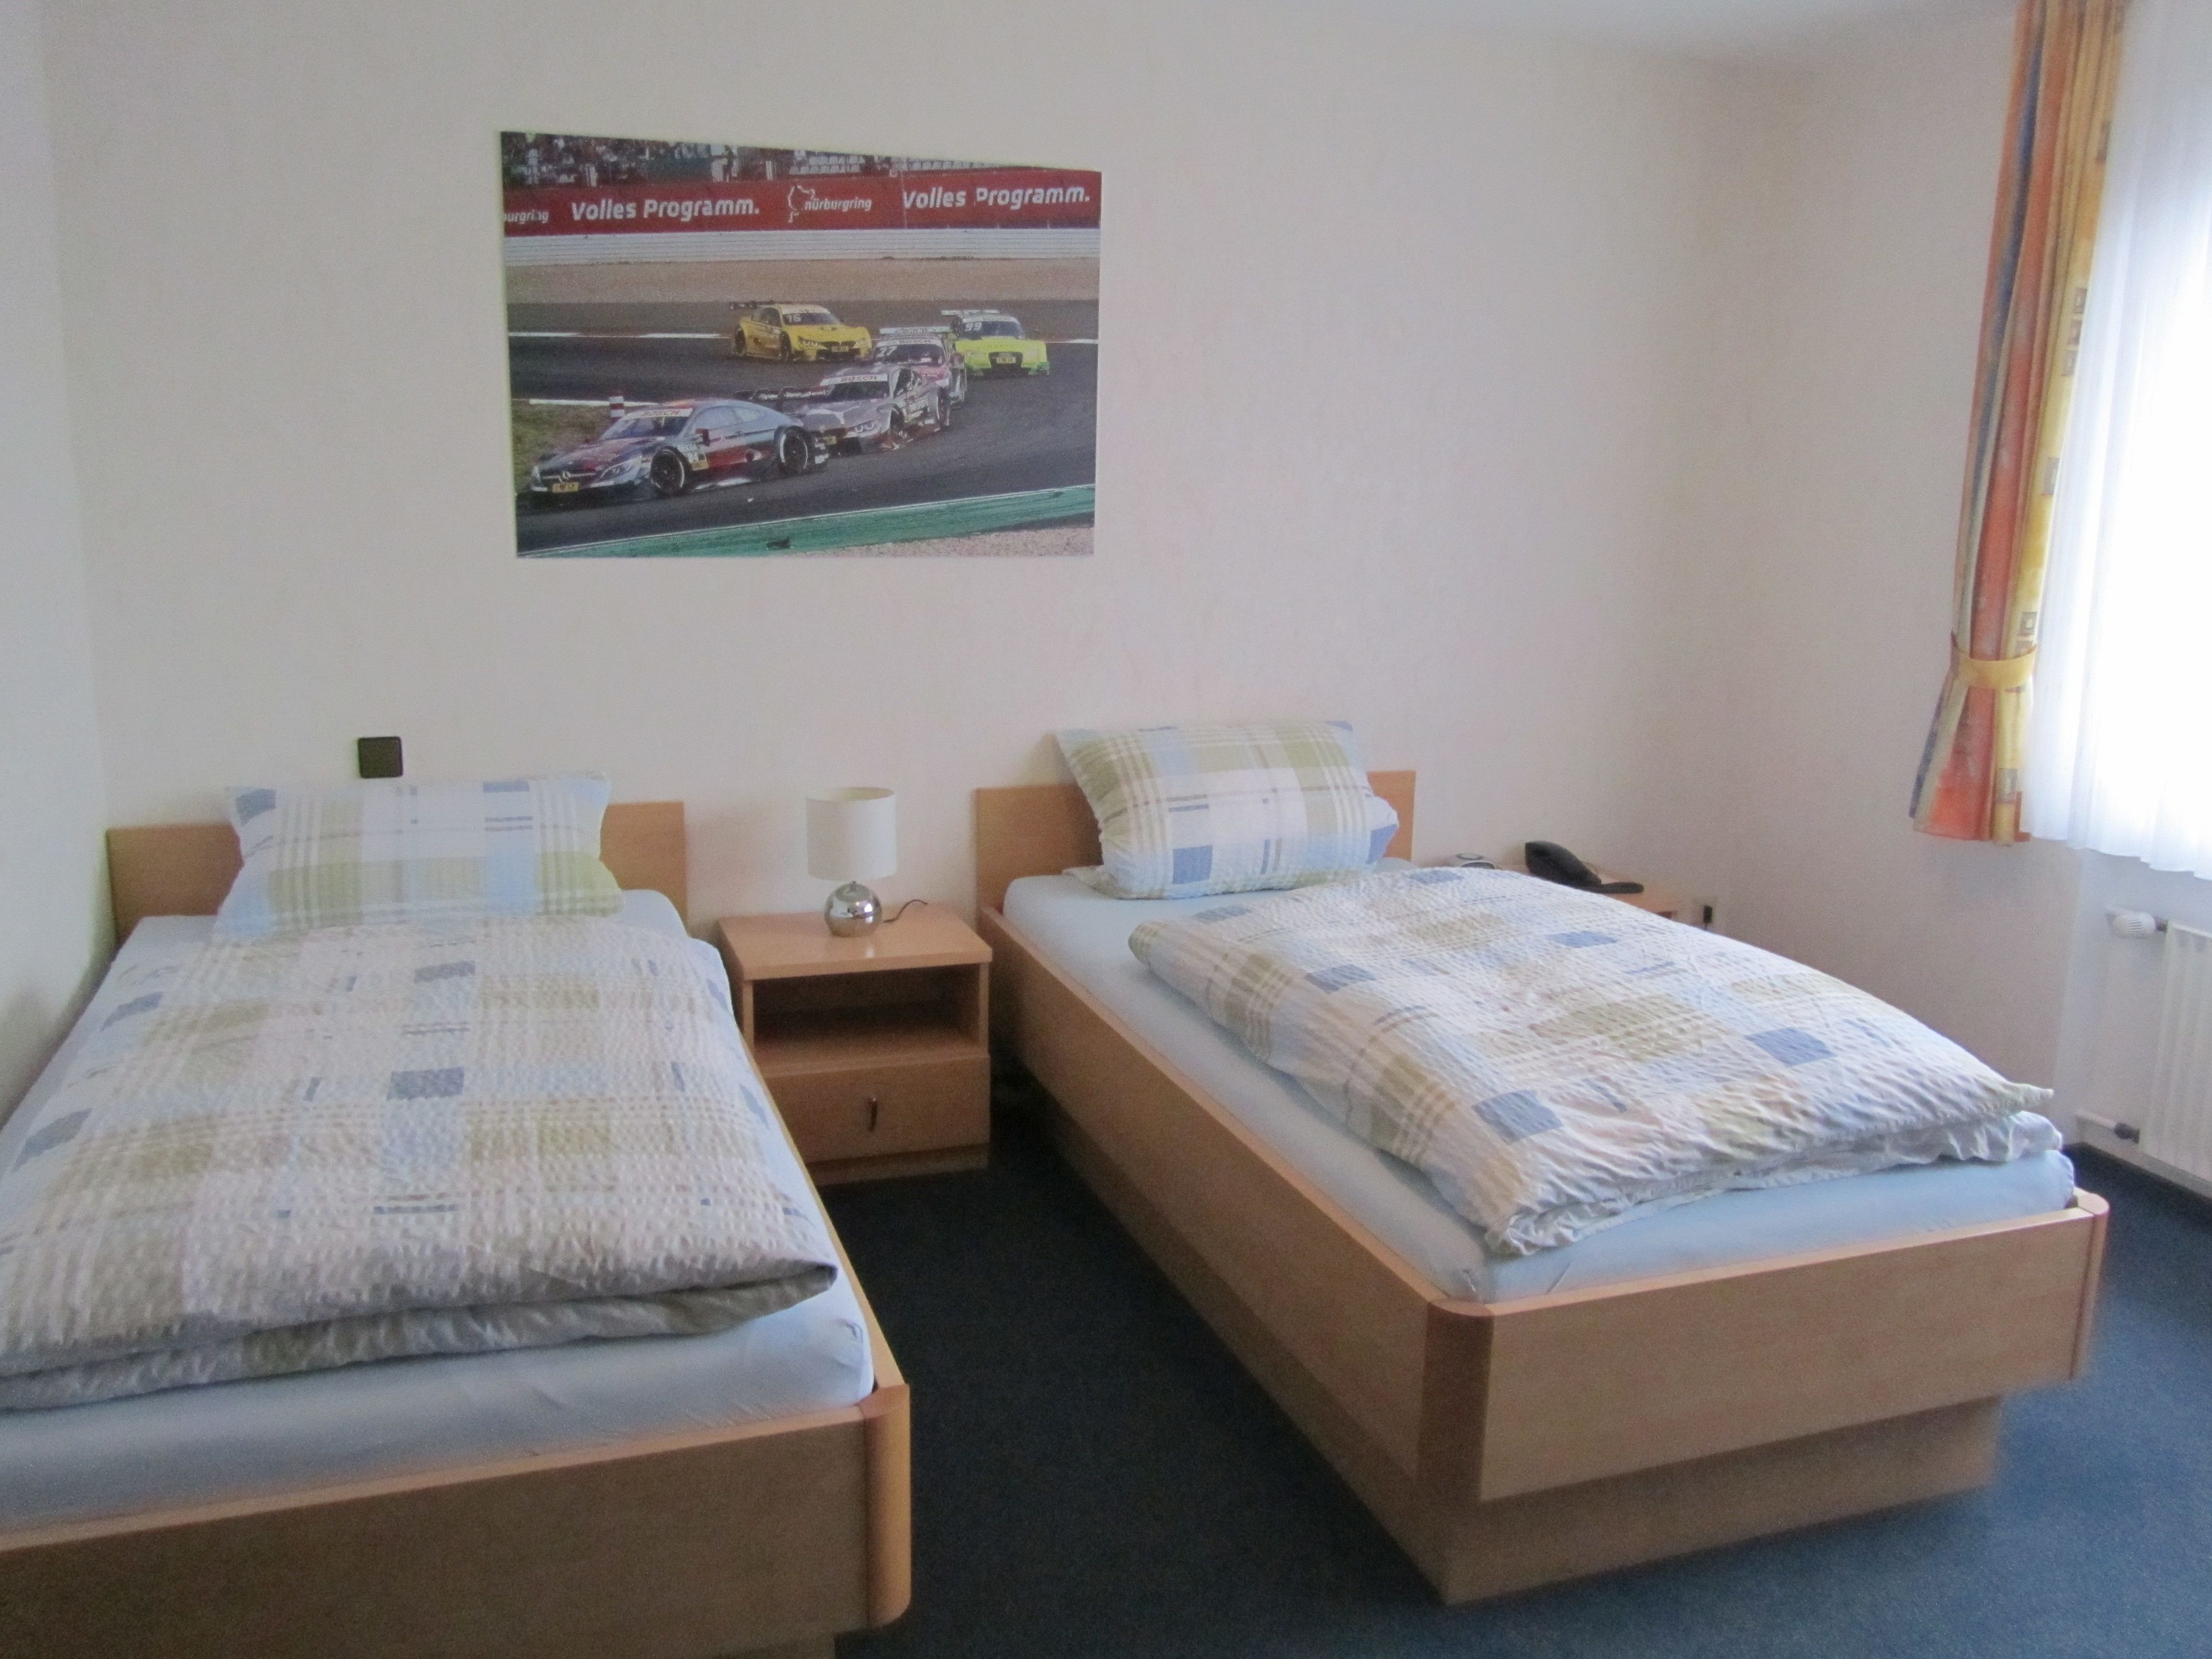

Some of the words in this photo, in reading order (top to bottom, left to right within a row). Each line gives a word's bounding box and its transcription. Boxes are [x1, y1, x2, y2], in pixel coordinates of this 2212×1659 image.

[804, 198, 872, 211] nürburgring
[902, 187, 966, 209] Volles
[975, 185, 1090, 211] Programm.
[571, 199, 637, 221] Volles
[643, 198, 760, 222] Programm.
[876, 346, 897, 358] 27
